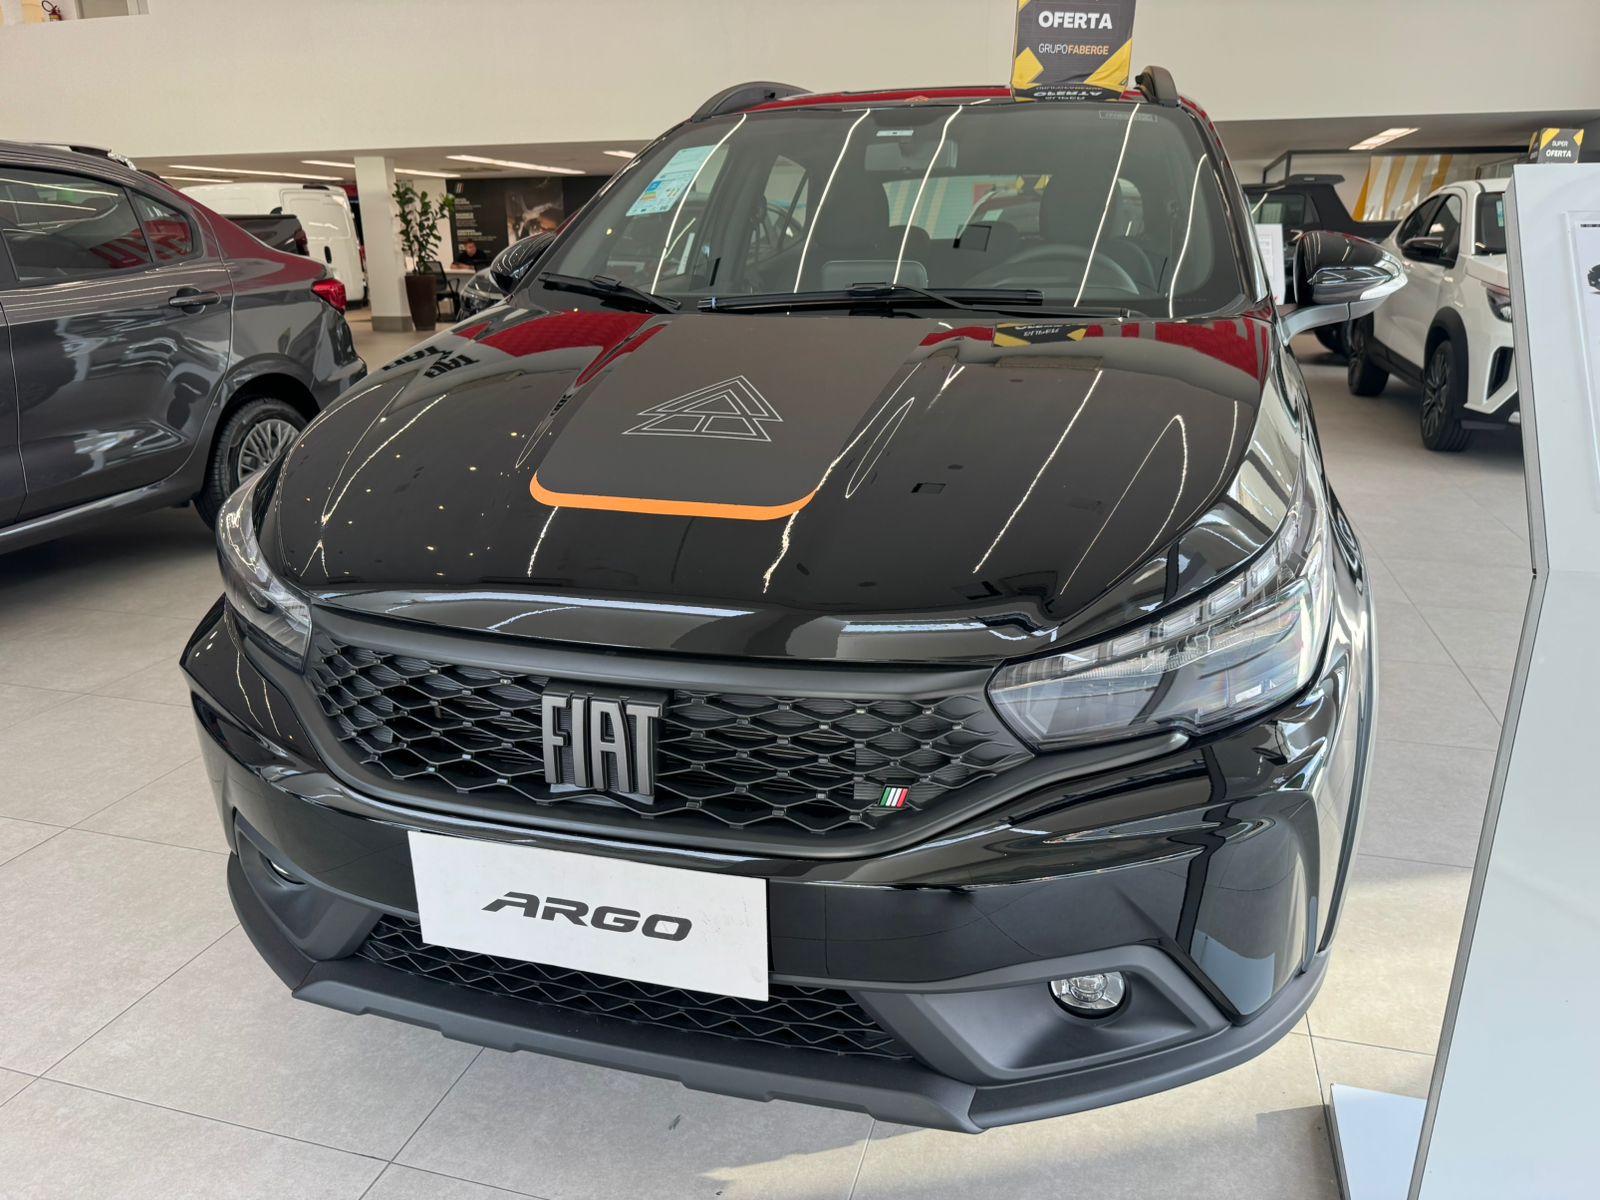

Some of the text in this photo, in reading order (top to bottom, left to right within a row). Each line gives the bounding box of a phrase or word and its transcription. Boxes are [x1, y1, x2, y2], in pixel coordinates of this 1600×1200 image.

[1038, 10, 1113, 30] OFERTA
[1545, 149, 1572, 158] OFERTA
[541, 694, 661, 797] FIAT
[481, 890, 694, 942] ARGO
